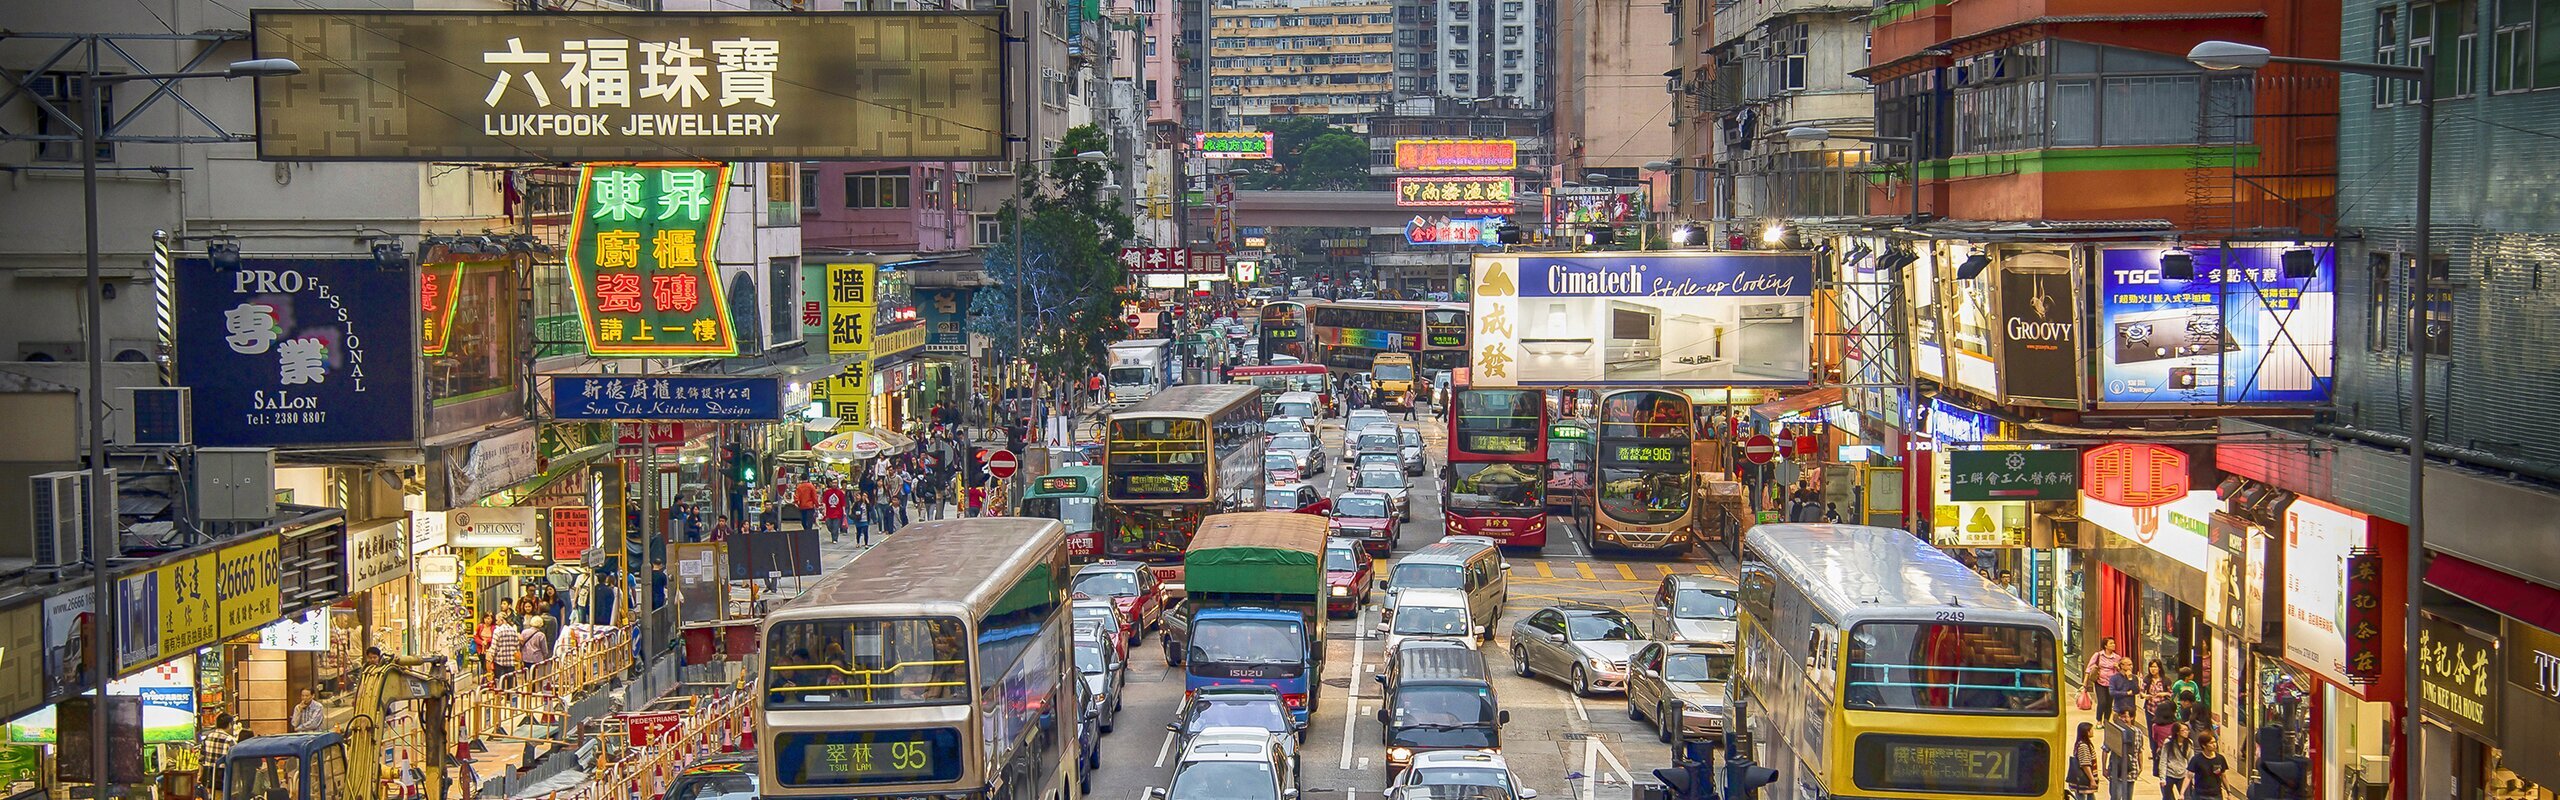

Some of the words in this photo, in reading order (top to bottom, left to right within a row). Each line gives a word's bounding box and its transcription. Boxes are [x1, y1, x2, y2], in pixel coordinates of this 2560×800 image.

[484, 37, 780, 107] 六福珠寶
[484, 114, 611, 136] LUKFOOK
[621, 114, 781, 136] JEWELLERY
[591, 169, 711, 221] 東昇
[595, 230, 698, 269] 廚櫃
[1548, 264, 1643, 293] Cimatech
[1649, 276, 1730, 298] Style-up
[1732, 270, 1795, 297] Cooking
[2113, 269, 2160, 285] TGC
[596, 273, 698, 313] 瓷磚
[224, 303, 325, 385] 專業
[599, 318, 717, 342] 請上一樓
[1479, 302, 1513, 379] 成發
[2008, 317, 2072, 342] GROOVY
[833, 269, 864, 426] 牆紙特區
[247, 413, 271, 425] Tel:
[275, 412, 299, 424] 2380
[302, 411, 326, 423] 8807
[582, 402, 609, 415] Sun
[615, 402, 642, 414] Tak
[647, 402, 699, 414] Kitchen
[705, 402, 751, 417] Design
[1653, 447, 1671, 461] 905
[1956, 471, 2074, 486] 工聯會工人醫療所
[476, 523, 520, 534] DELONG
[174, 559, 201, 604] 堅達
[220, 553, 256, 601] 26666
[258, 547, 279, 588] 168
[1936, 611, 1965, 621] 2249
[2350, 562, 2378, 672] 英記茶莊
[1230, 669, 1263, 677] ISUZU
[2420, 629, 2489, 698] 英記茶莊
[2422, 679, 2437, 704] YING
[2437, 686, 2449, 710] KEE
[2450, 692, 2462, 716] TEA
[2463, 697, 2484, 725] HOUSE
[630, 715, 678, 725] PEDESTRIANS
[826, 744, 873, 763] 翠林
[891, 741, 926, 770] 95
[829, 764, 848, 772] TSUI
[1968, 750, 2011, 779] E21
